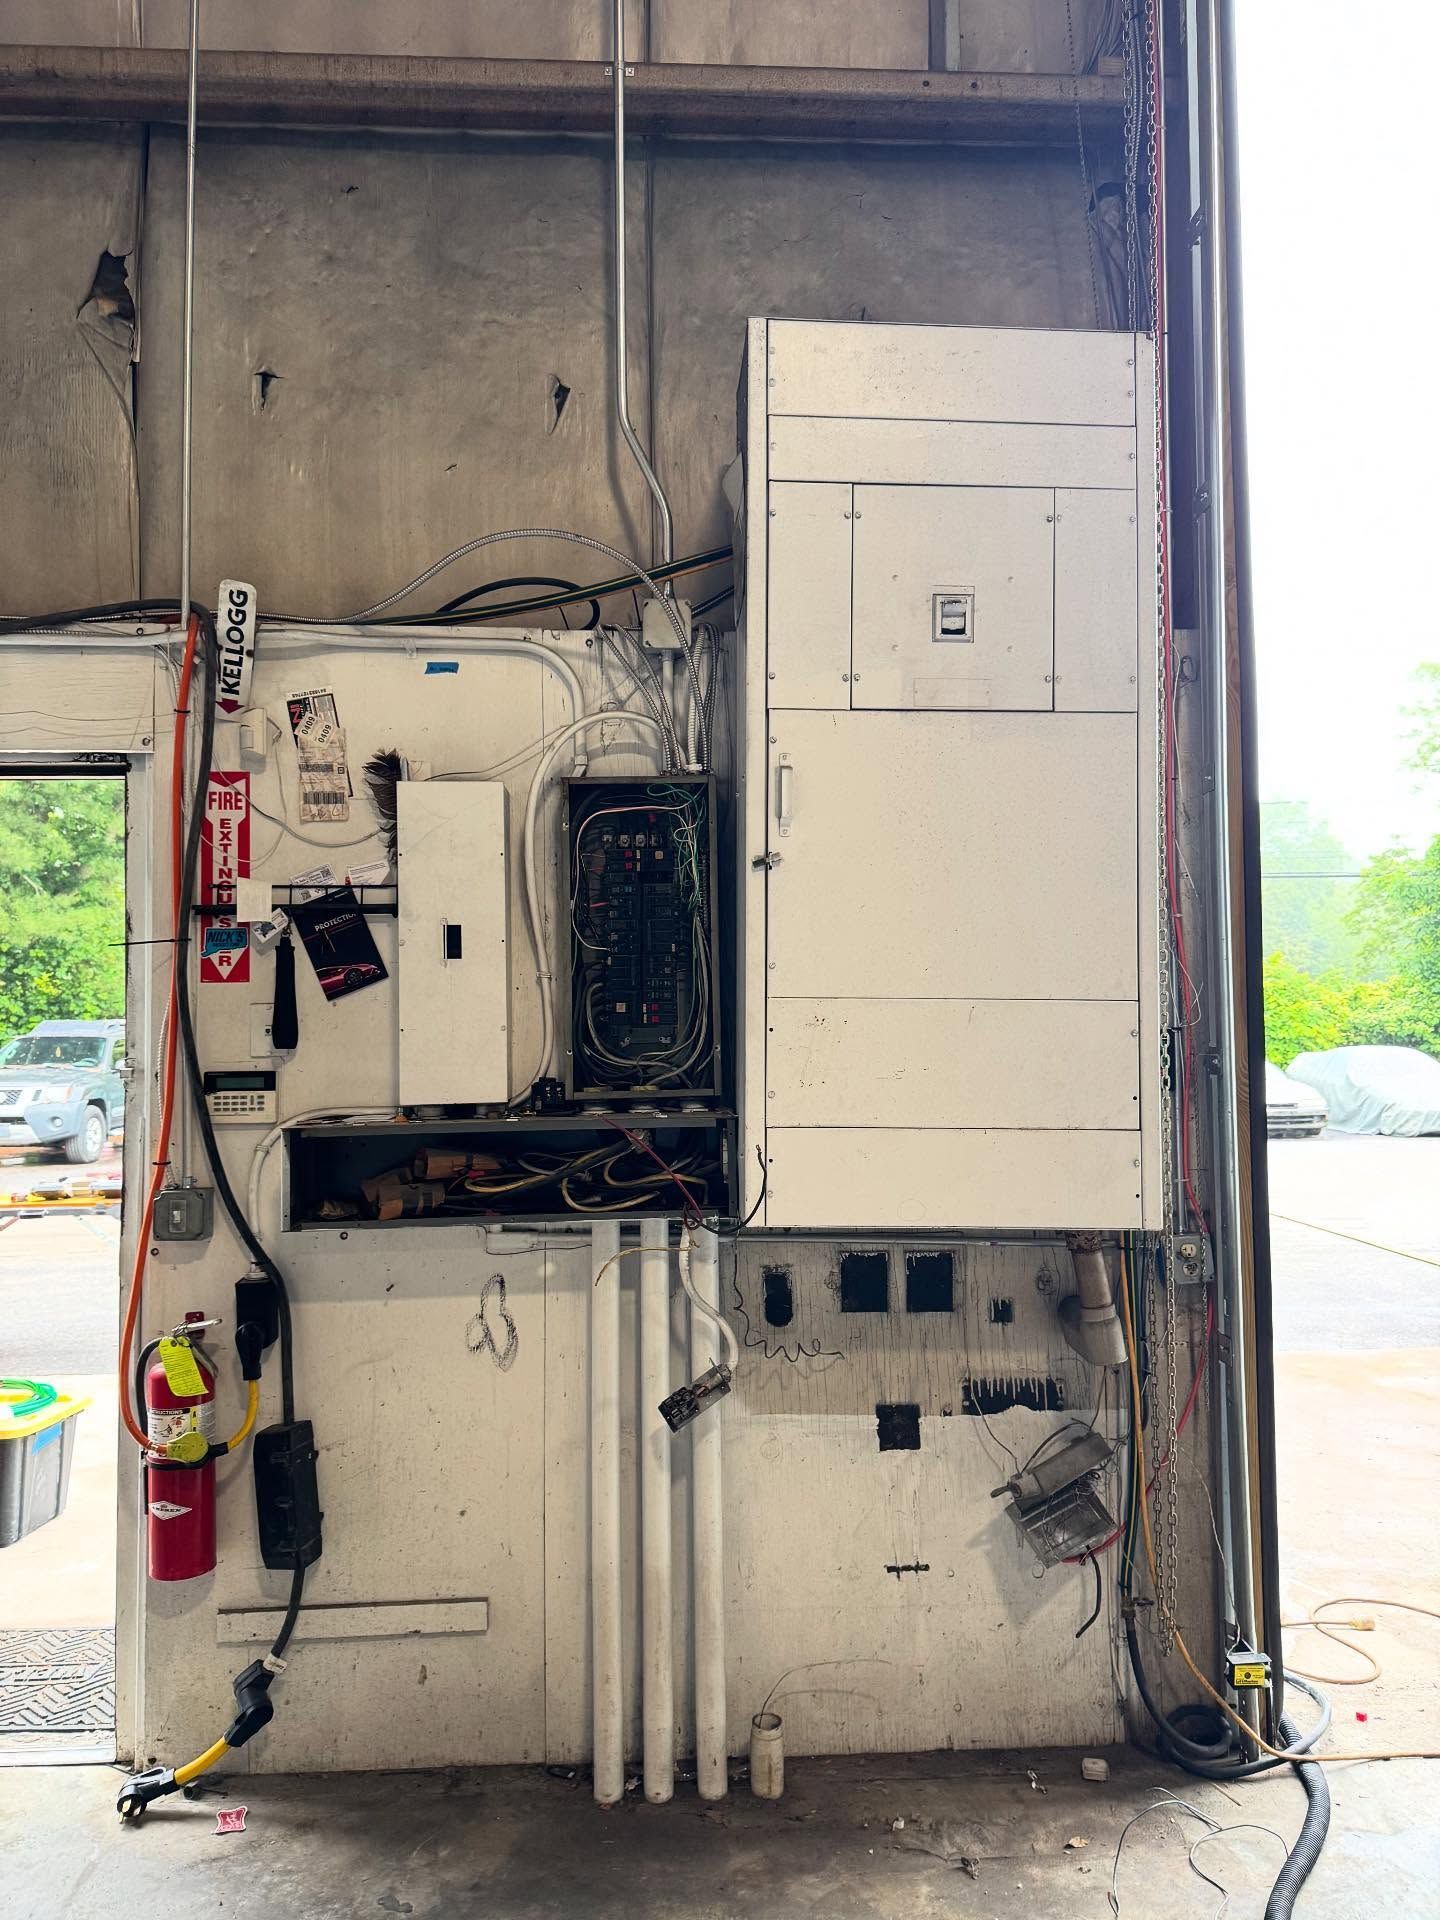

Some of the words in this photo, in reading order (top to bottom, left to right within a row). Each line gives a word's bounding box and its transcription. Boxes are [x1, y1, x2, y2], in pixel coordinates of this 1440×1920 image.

[221, 589, 248, 695] KELLOGG
[301, 716, 316, 735] 0409
[317, 724, 332, 743] 0409
[208, 791, 243, 811] FIRE
